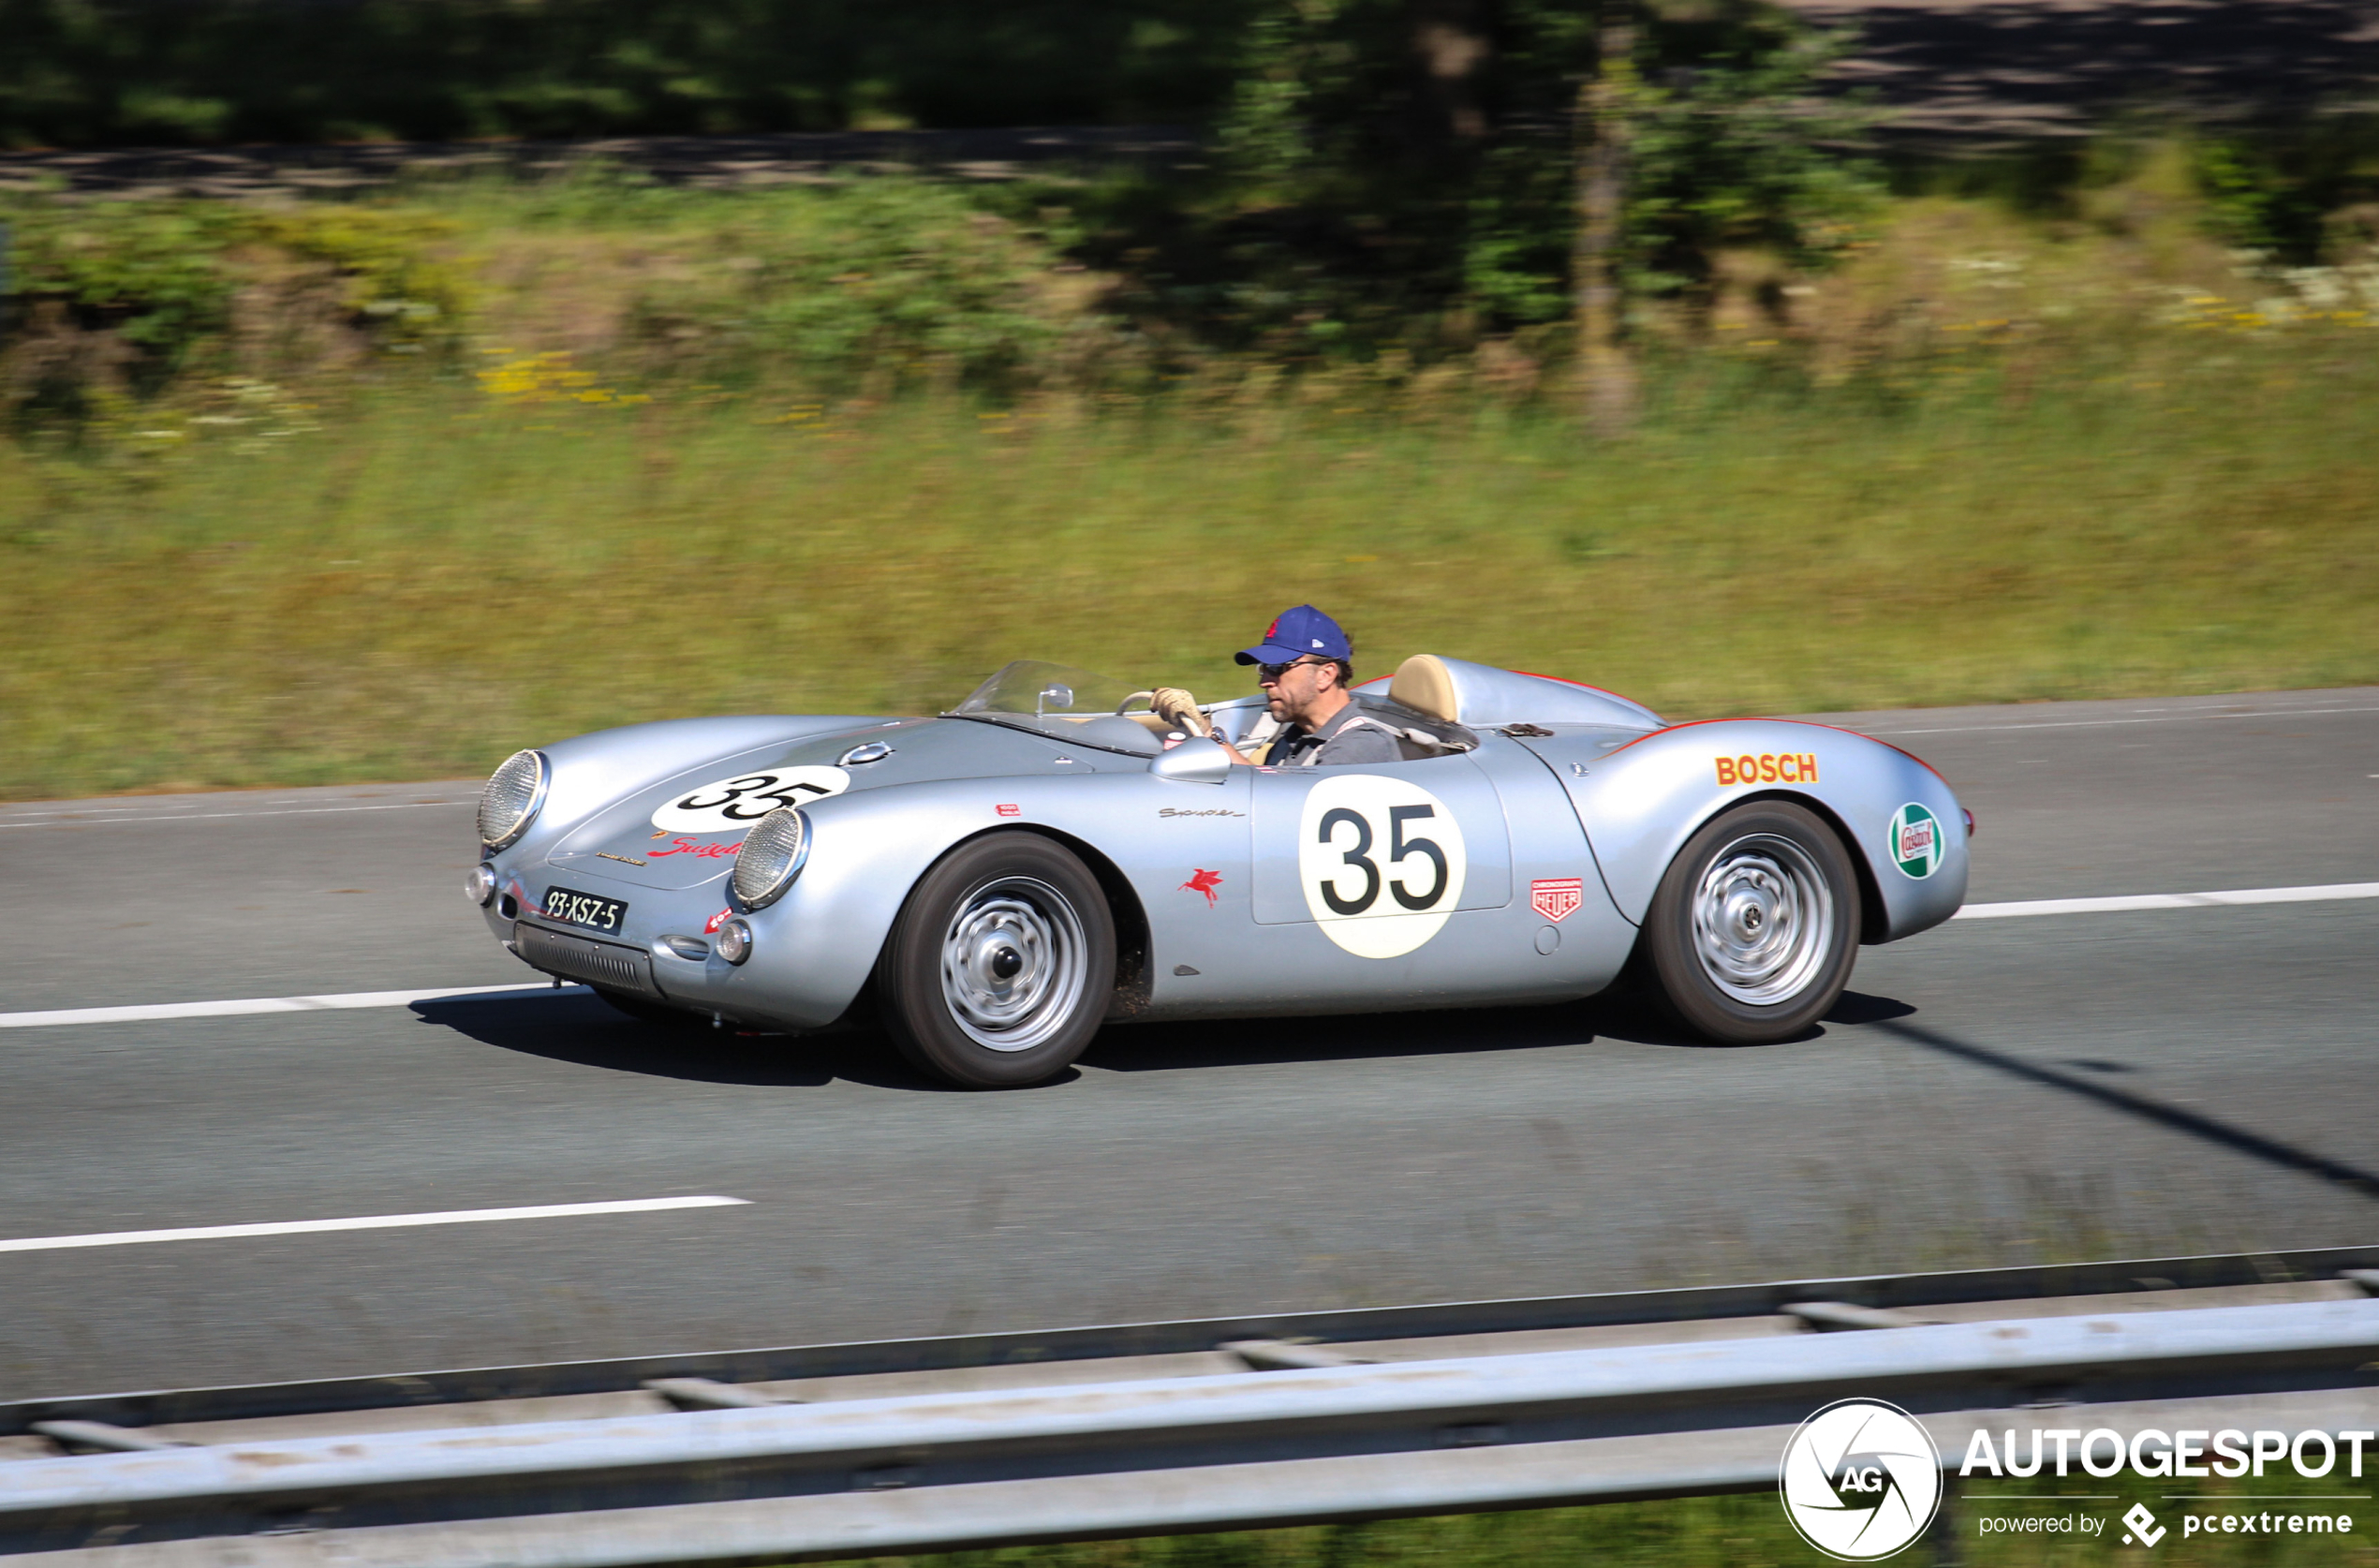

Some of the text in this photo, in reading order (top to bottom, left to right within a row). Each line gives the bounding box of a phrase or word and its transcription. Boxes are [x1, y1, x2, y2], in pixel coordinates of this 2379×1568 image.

[1714, 753, 1819, 786] BOSCH
[677, 776, 833, 821] 35
[1319, 804, 1448, 916] 35
[547, 891, 619, 929] 93-XSZ-5
[709, 908, 732, 928] TOW
[1536, 892, 1578, 916] HEUER
